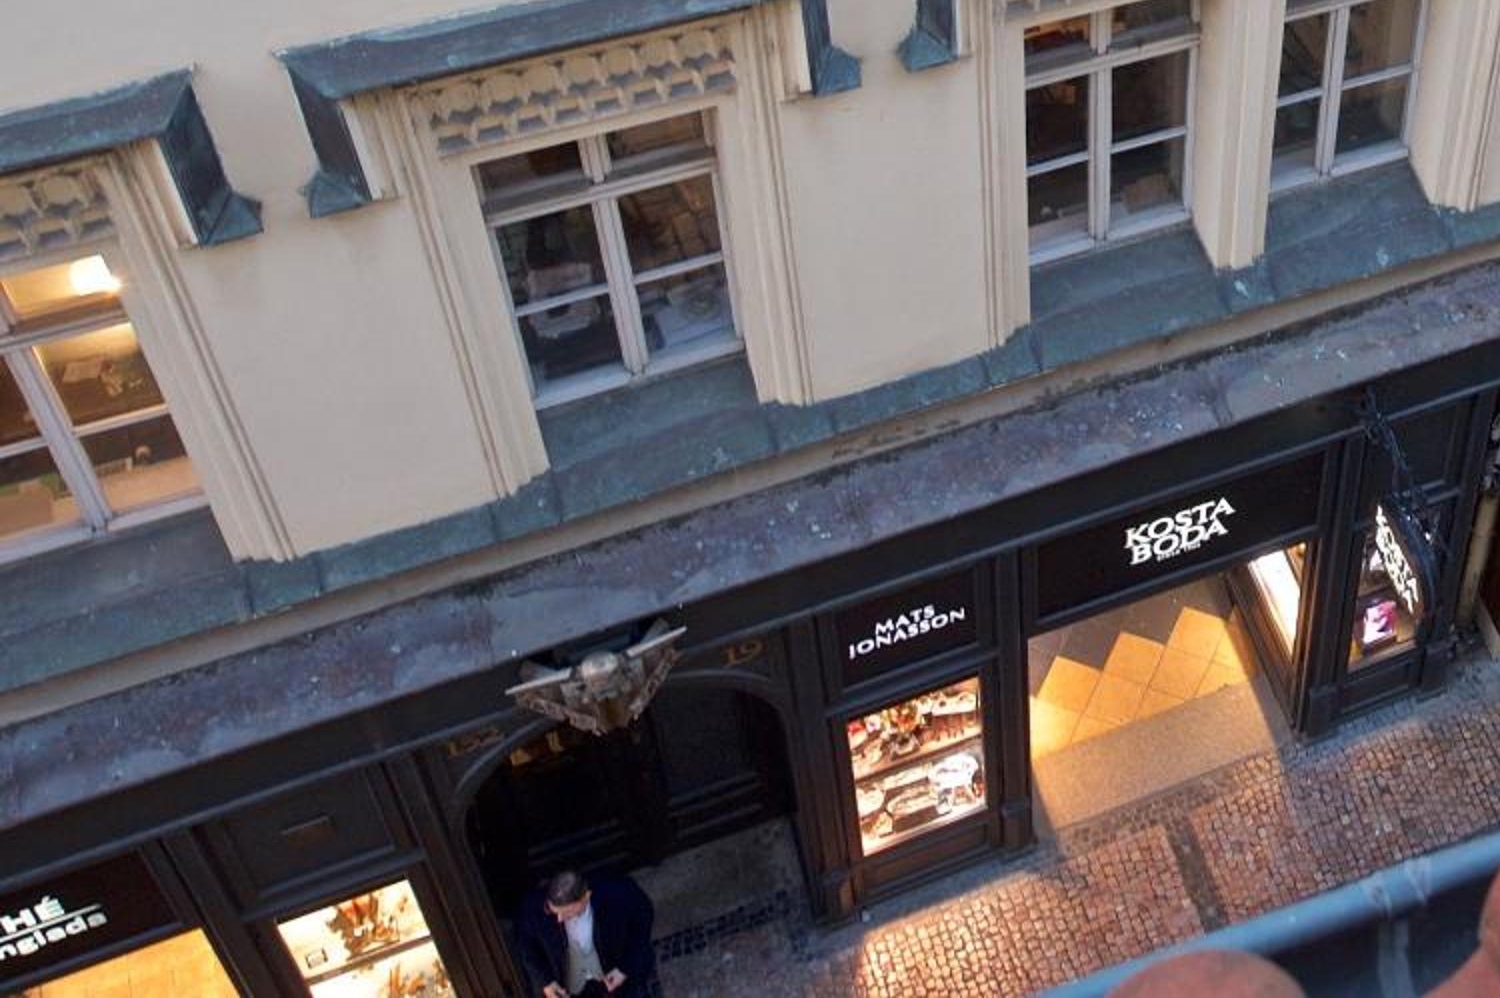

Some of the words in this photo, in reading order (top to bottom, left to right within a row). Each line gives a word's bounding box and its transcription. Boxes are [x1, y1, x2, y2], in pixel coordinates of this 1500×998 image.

[1124, 497, 1236, 549] KOSTA
[1130, 518, 1229, 565] BODA
[875, 604, 935, 635] MATS
